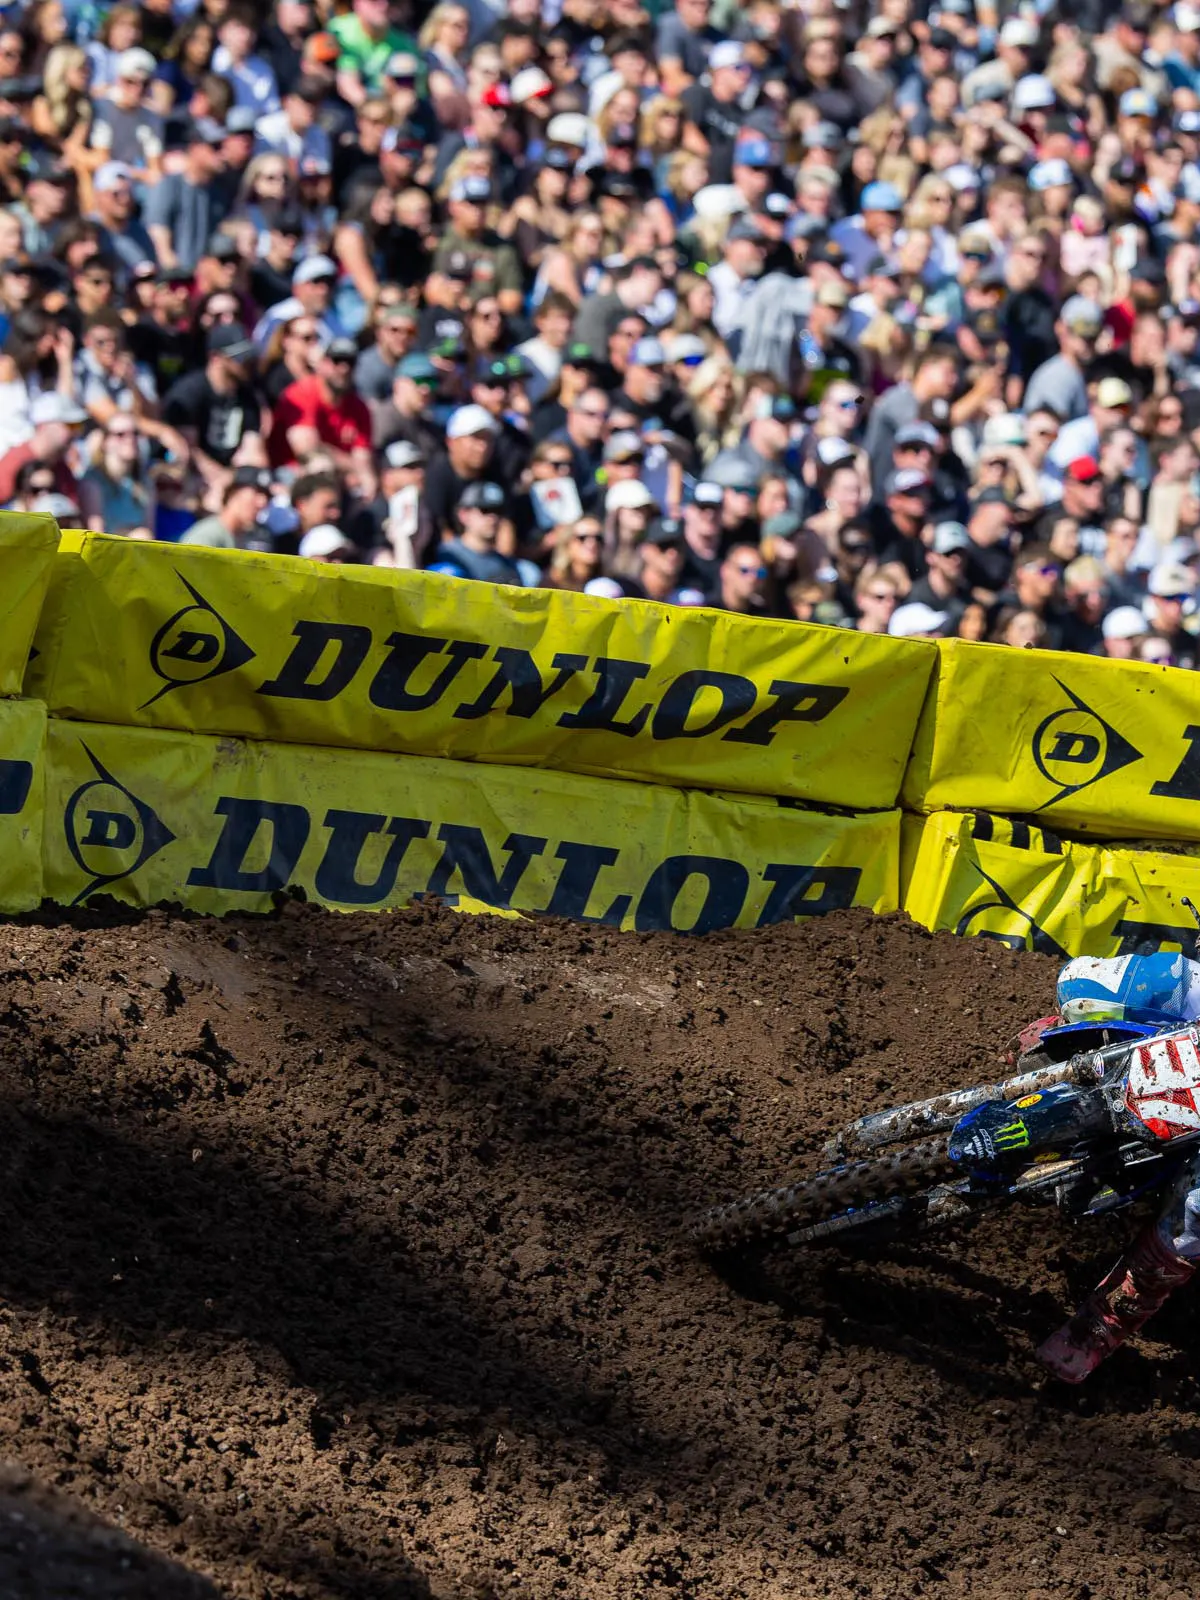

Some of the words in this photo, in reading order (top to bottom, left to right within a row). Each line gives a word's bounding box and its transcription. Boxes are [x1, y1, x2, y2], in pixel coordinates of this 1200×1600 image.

[160, 631, 219, 663] D
[256, 620, 850, 746] DUNLOP
[1045, 731, 1101, 765] D
[80, 809, 136, 850] D
[186, 796, 863, 935] DUNLOP
